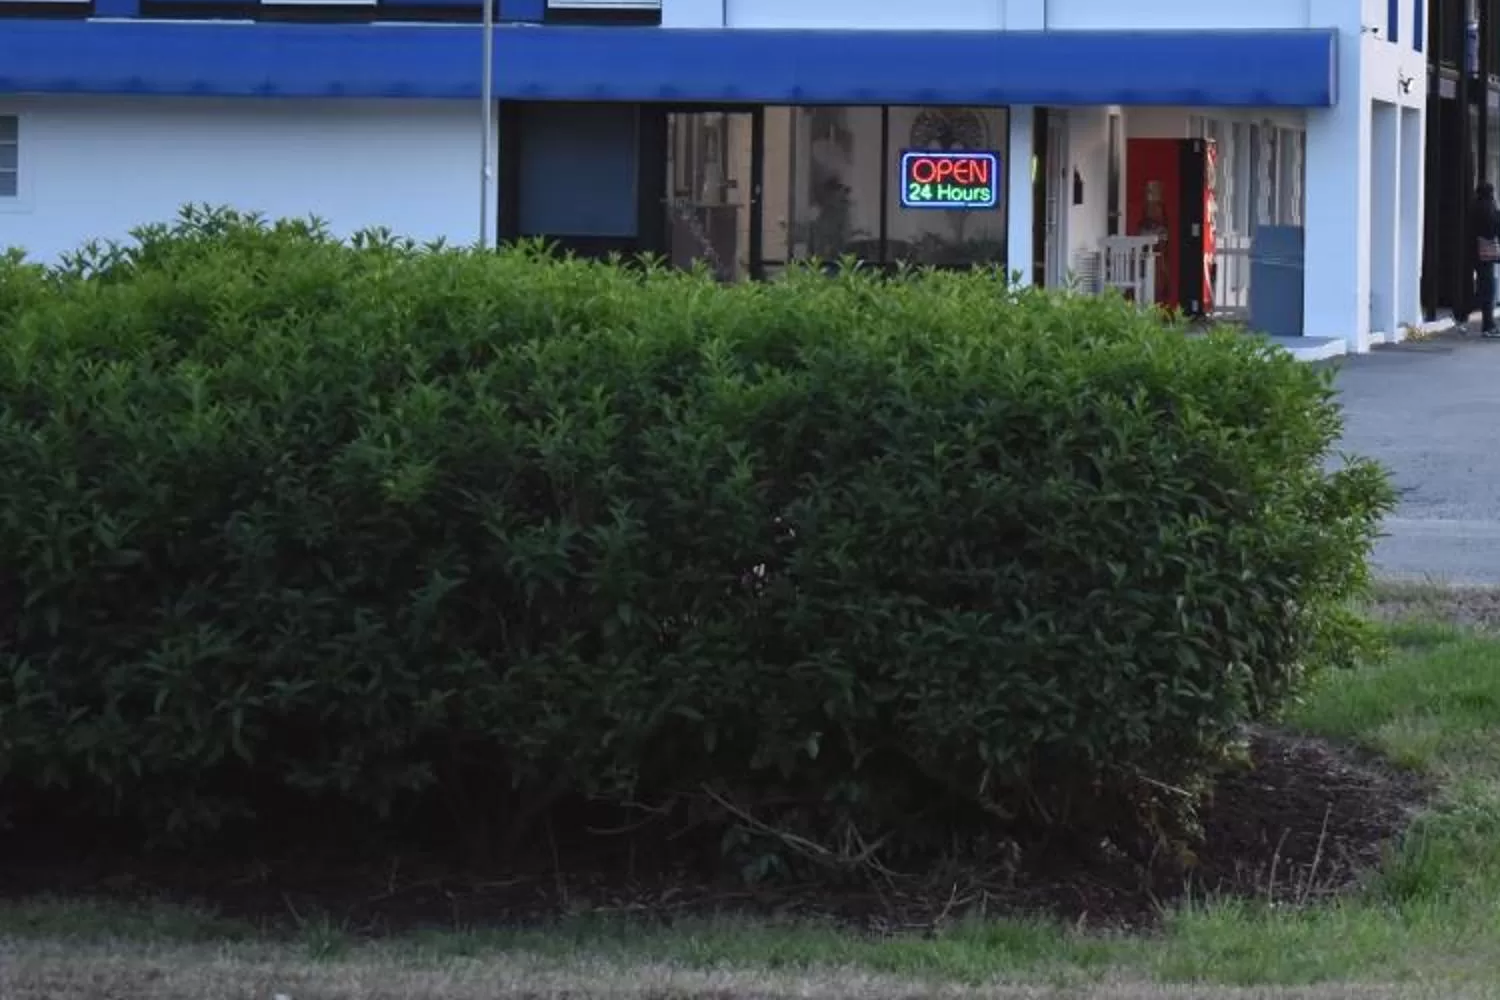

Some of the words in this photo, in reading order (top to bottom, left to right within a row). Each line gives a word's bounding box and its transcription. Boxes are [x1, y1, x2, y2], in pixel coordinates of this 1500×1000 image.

[912, 158, 987, 183] OPEN
[909, 183, 932, 201] 24
[937, 183, 991, 201] Hours
